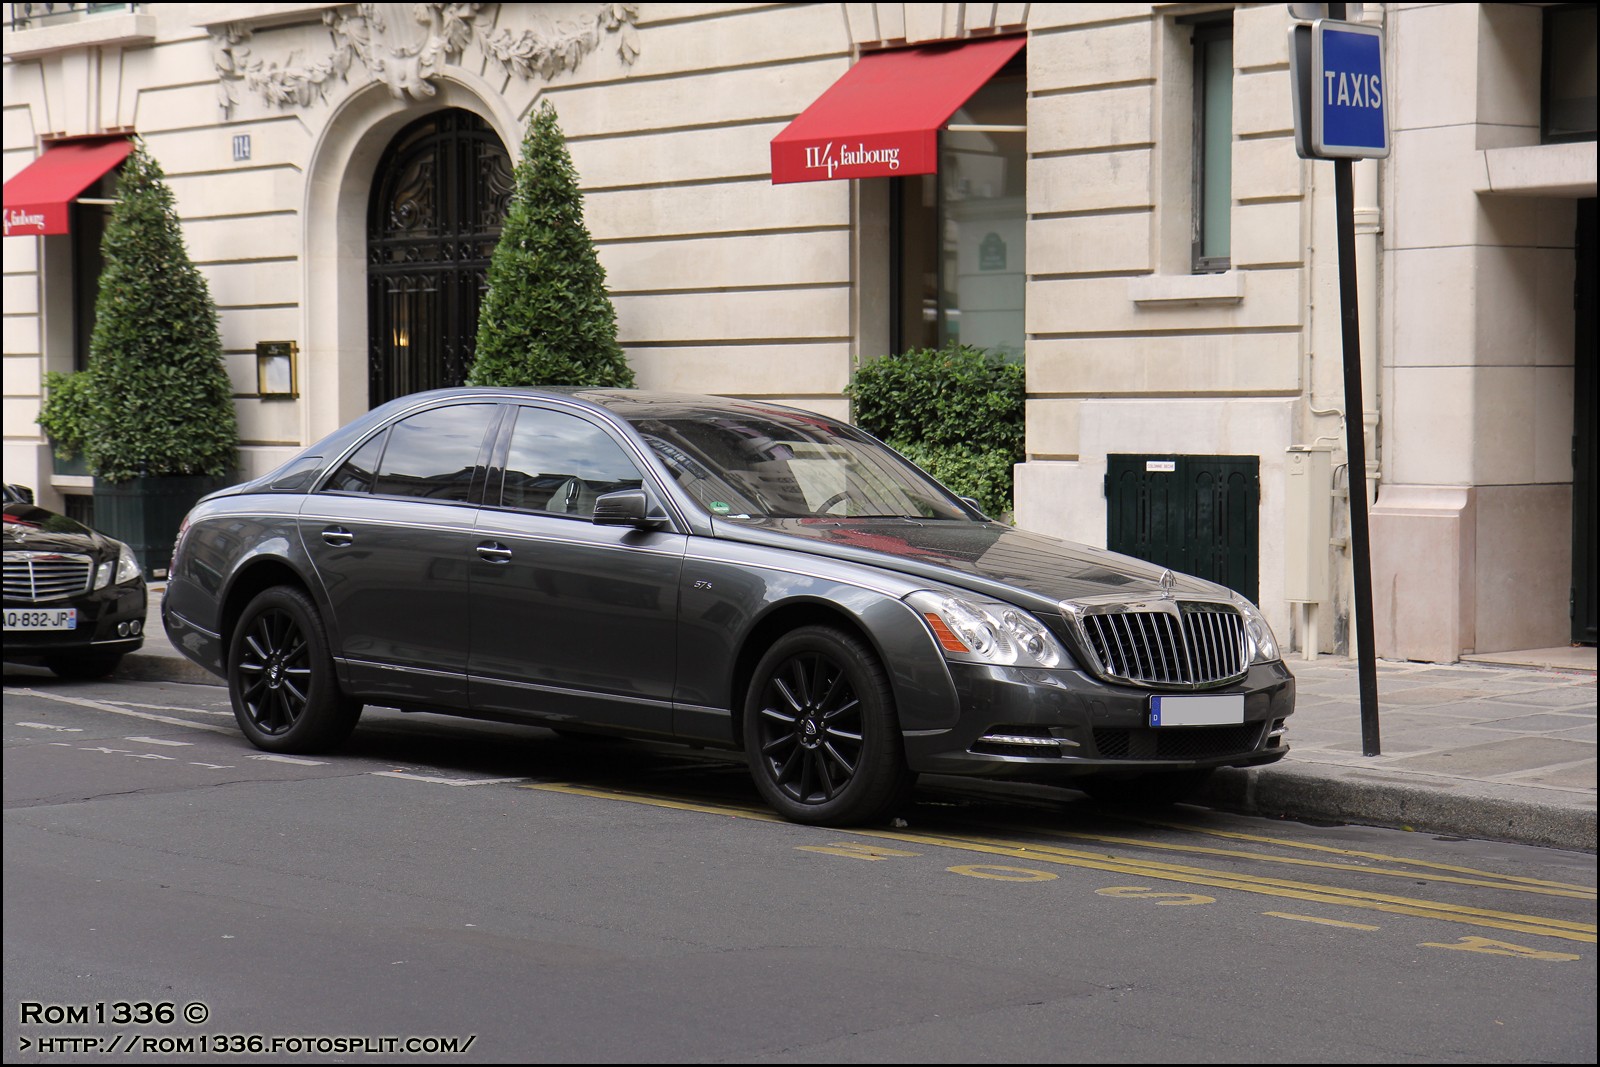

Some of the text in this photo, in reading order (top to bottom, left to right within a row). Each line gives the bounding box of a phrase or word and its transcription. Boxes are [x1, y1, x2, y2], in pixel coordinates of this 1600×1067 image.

[1324, 70, 1382, 109] TAXIS
[234, 136, 250, 157] 114
[840, 143, 900, 170] faubourg
[11, 209, 45, 230] faubourg
